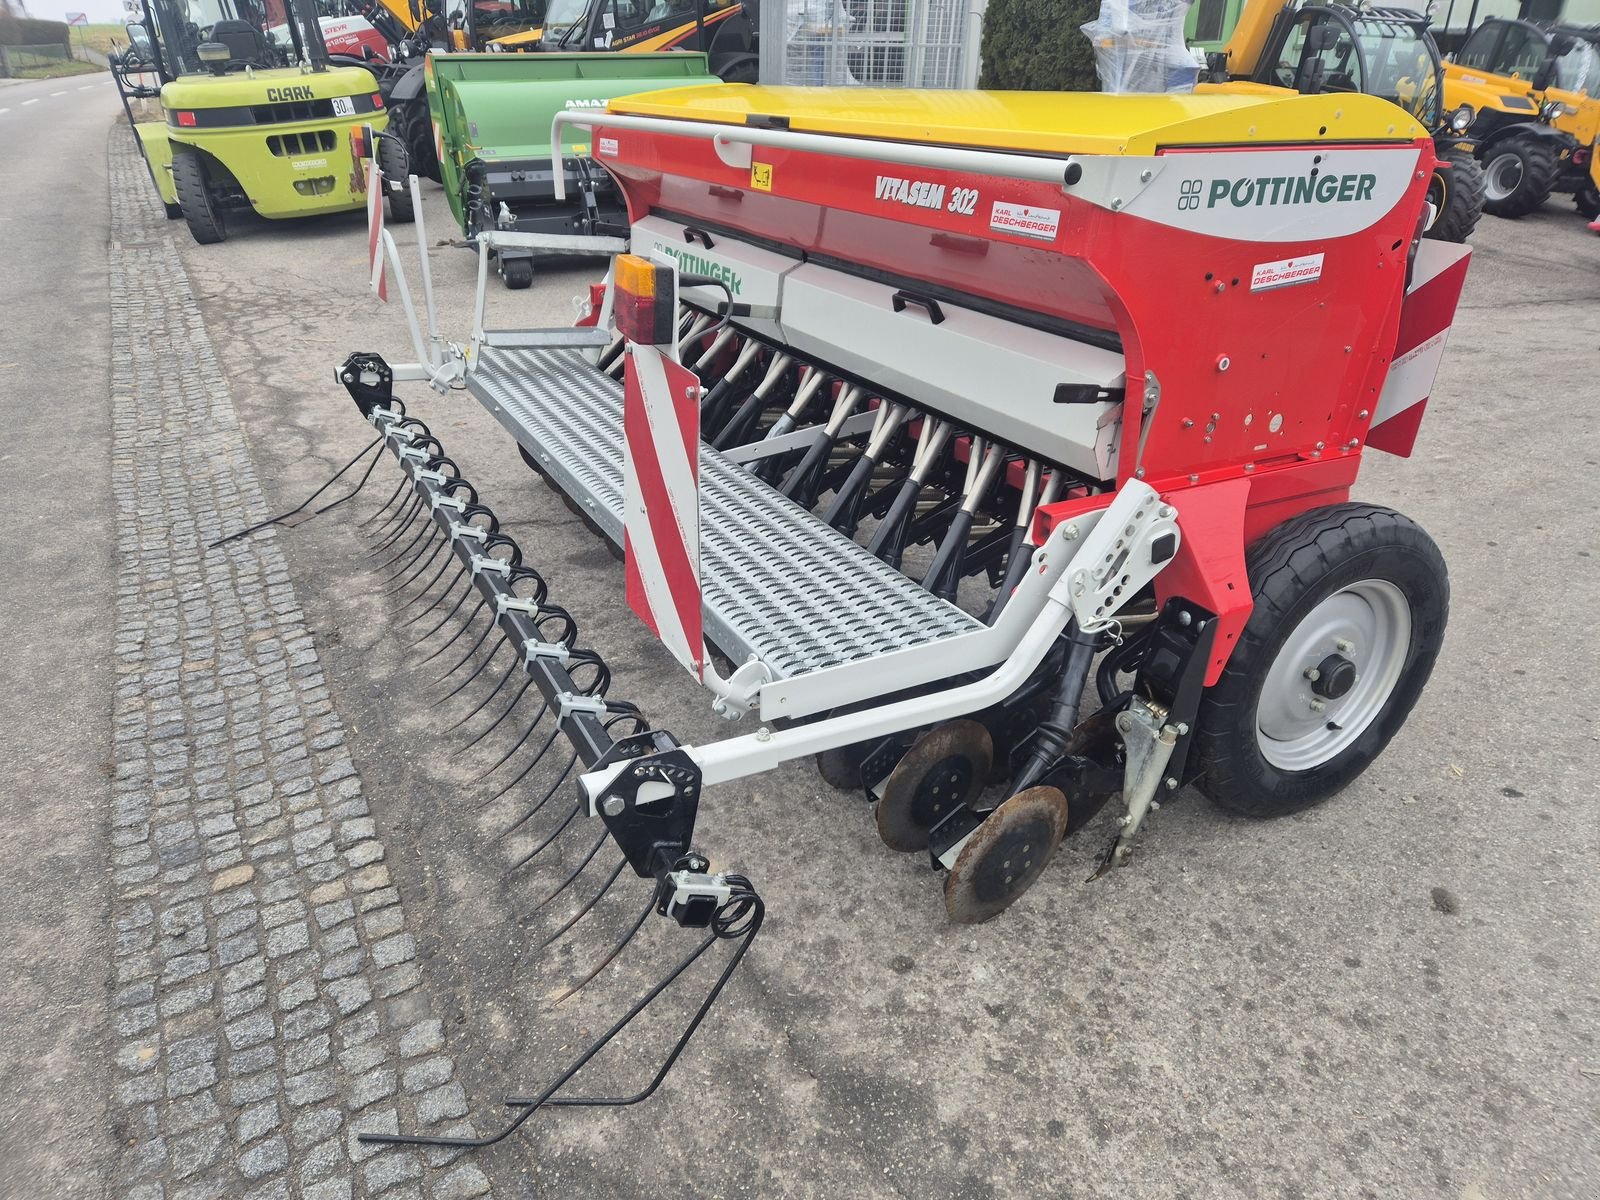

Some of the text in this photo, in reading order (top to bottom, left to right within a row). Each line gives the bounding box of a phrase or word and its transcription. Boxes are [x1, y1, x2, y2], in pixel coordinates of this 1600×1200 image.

[324, 23, 348, 35] STEYR
[611, 38, 623, 47] AGRI
[623, 34, 636, 43] STAR
[267, 85, 314, 102] CLARK
[333, 99, 347, 114] 30
[565, 99, 609, 108] AMAZ
[875, 175, 979, 216] VITASEM 302
[1207, 174, 1376, 208] PÖTTINGER
[995, 208, 1011, 216] KARL
[992, 215, 1056, 233] DESCHBERGER
[1253, 266, 1320, 285] DESCHBERGER
[1256, 268, 1274, 276] KARL
